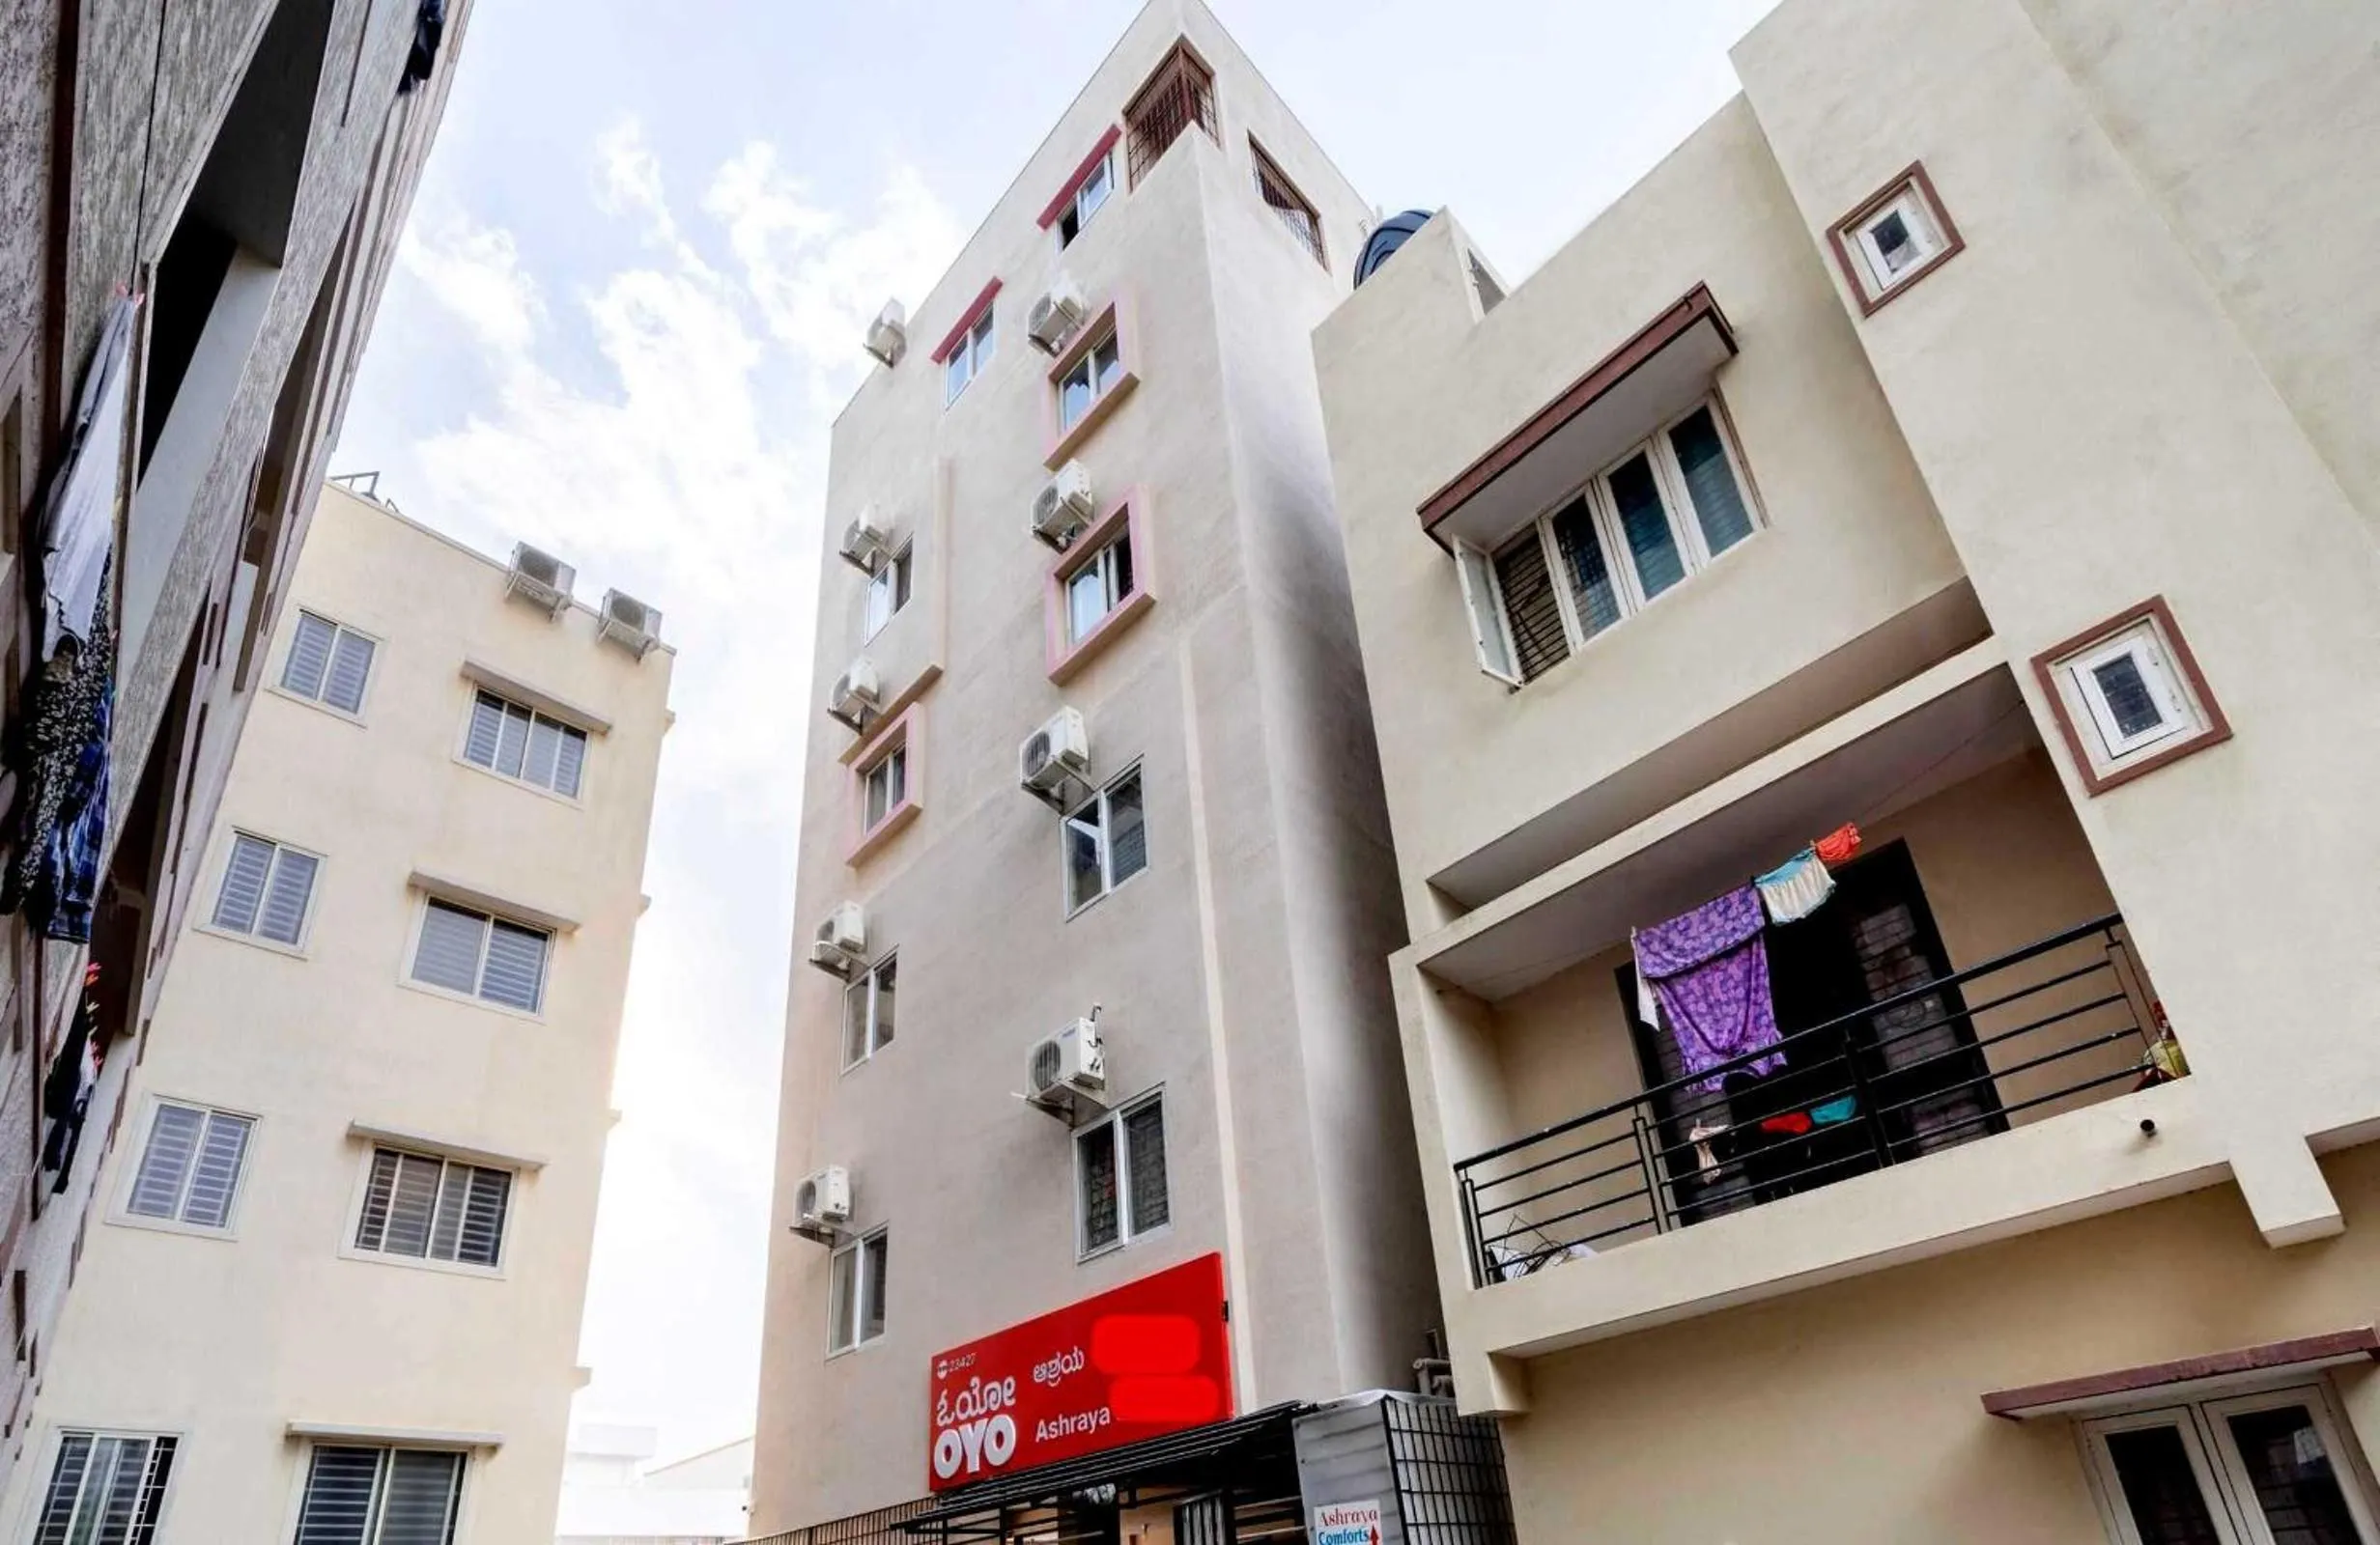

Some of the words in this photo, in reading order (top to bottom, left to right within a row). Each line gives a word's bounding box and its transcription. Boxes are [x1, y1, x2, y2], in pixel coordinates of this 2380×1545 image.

[936, 1376, 1016, 1427] ಓಯೋ
[1034, 1406, 1111, 1444] Ashraya
[934, 1414, 1016, 1479] OYO
[1318, 1526, 1370, 1545] Comforts
[1321, 1507, 1378, 1527] Ashraya
